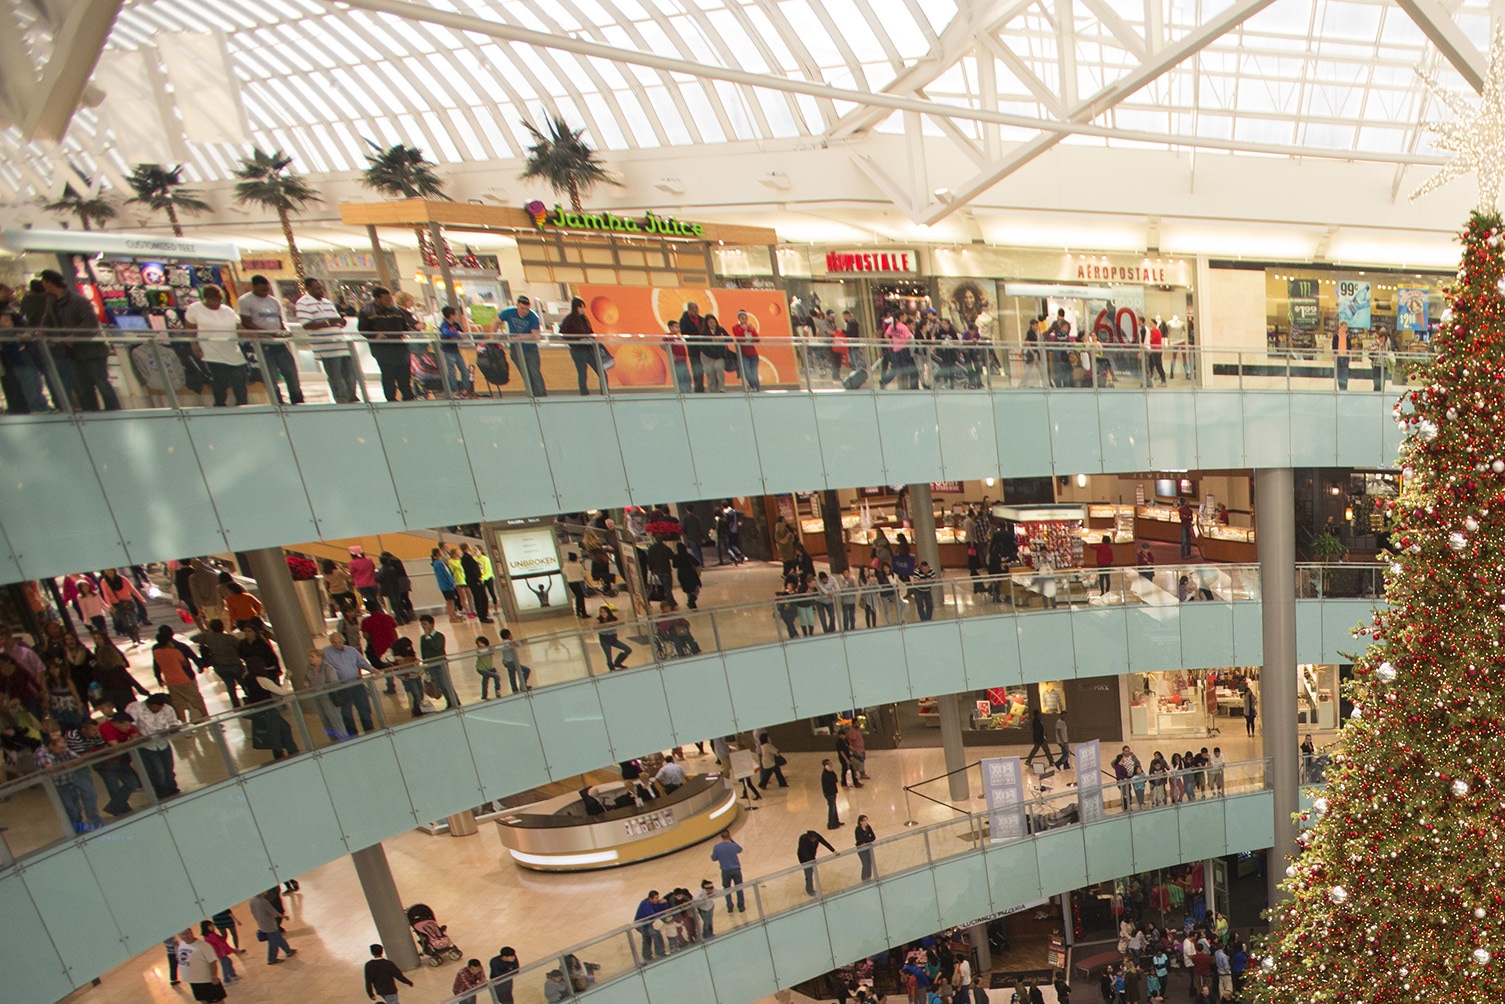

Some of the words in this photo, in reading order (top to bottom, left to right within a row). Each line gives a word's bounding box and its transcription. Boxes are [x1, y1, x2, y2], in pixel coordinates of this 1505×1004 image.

[553, 203, 641, 231] Jamba
[645, 209, 705, 237] Juice
[509, 556, 557, 569] UNBROKEN
